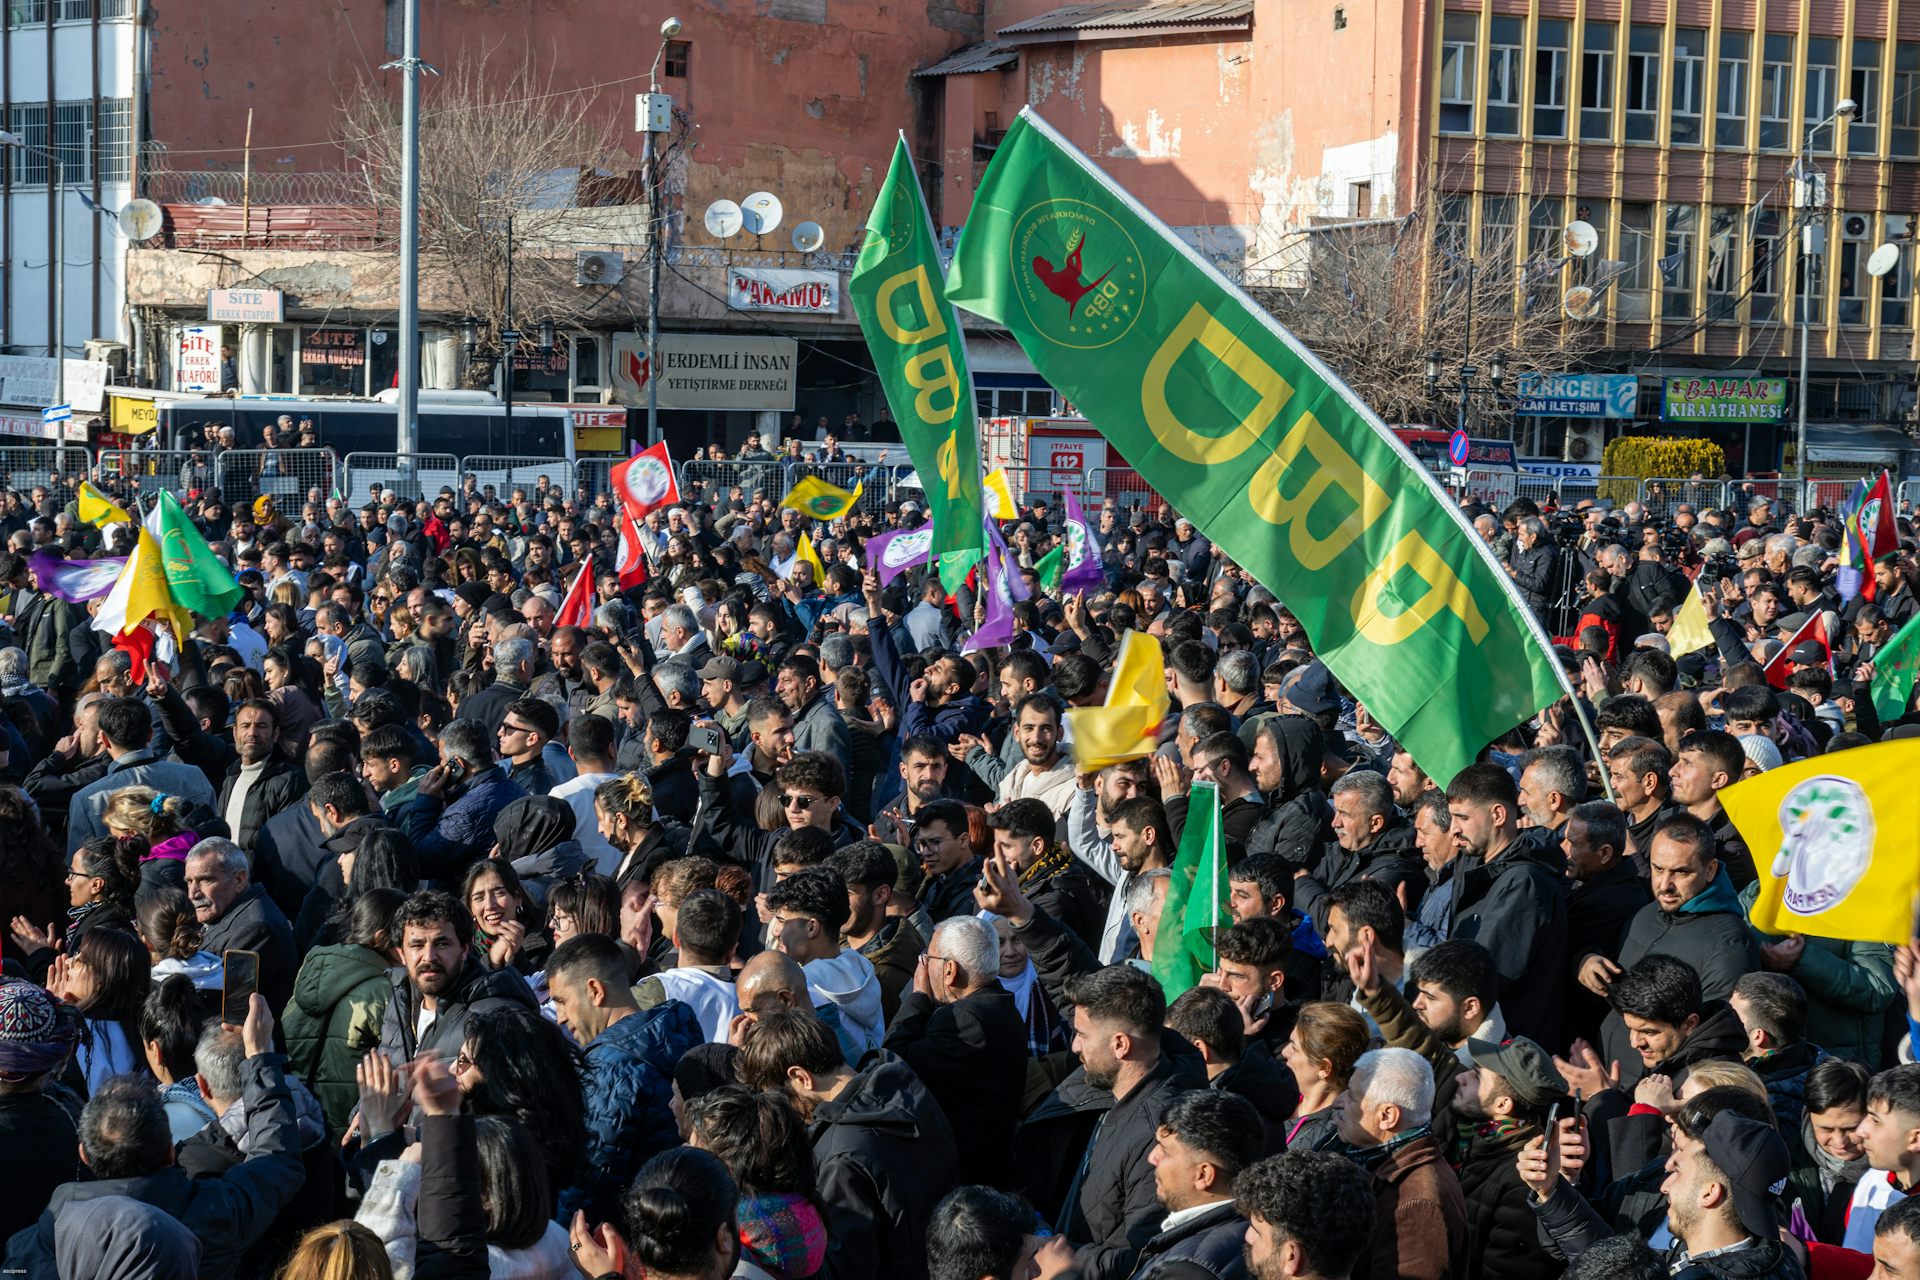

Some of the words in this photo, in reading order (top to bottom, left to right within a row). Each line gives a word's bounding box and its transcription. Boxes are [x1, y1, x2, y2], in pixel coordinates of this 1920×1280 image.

[185, 357, 210, 366] ERKEK
[667, 352, 738, 370] ERDEMLİ
[744, 352, 791, 371] İNSAN
[176, 367, 217, 383] KUAFÖRÜ
[668, 377, 736, 392] YETİŞTİRME
[739, 378, 788, 392] DERNEĞİ
[1685, 379, 1769, 400] BAHAR
[1055, 455, 1079, 469] 112
